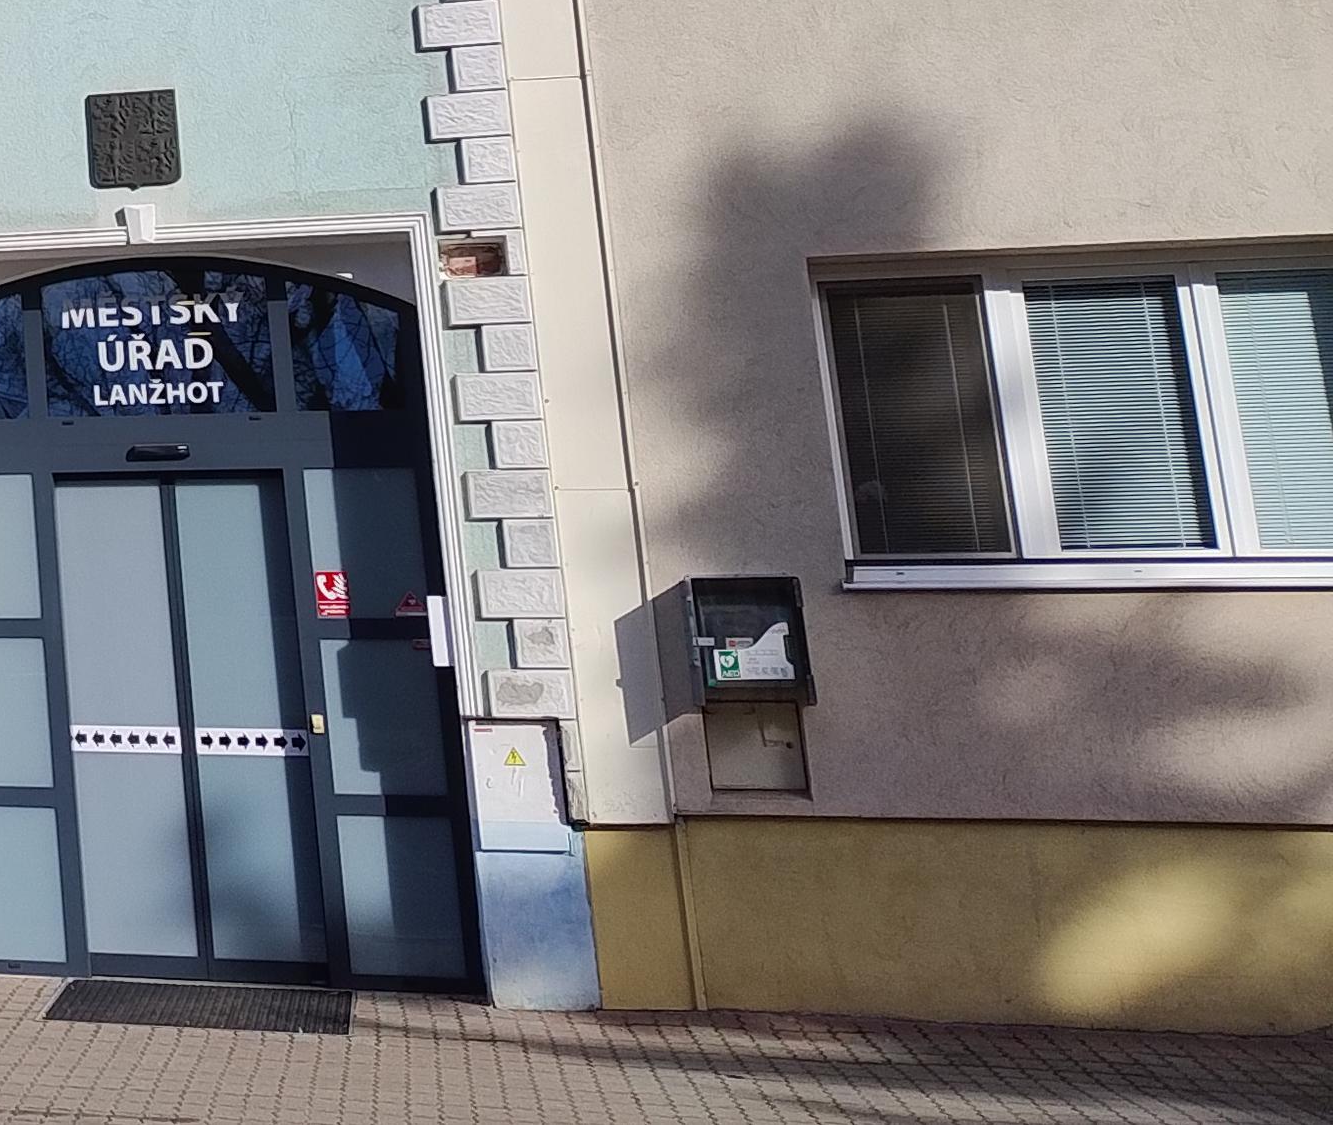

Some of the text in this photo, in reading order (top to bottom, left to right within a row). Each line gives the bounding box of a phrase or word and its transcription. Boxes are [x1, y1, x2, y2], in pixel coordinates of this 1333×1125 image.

[61, 286, 245, 330] MĚSTSKÝ
[97, 333, 214, 373] ÚŘAD
[93, 378, 224, 406] LANŽHOT
